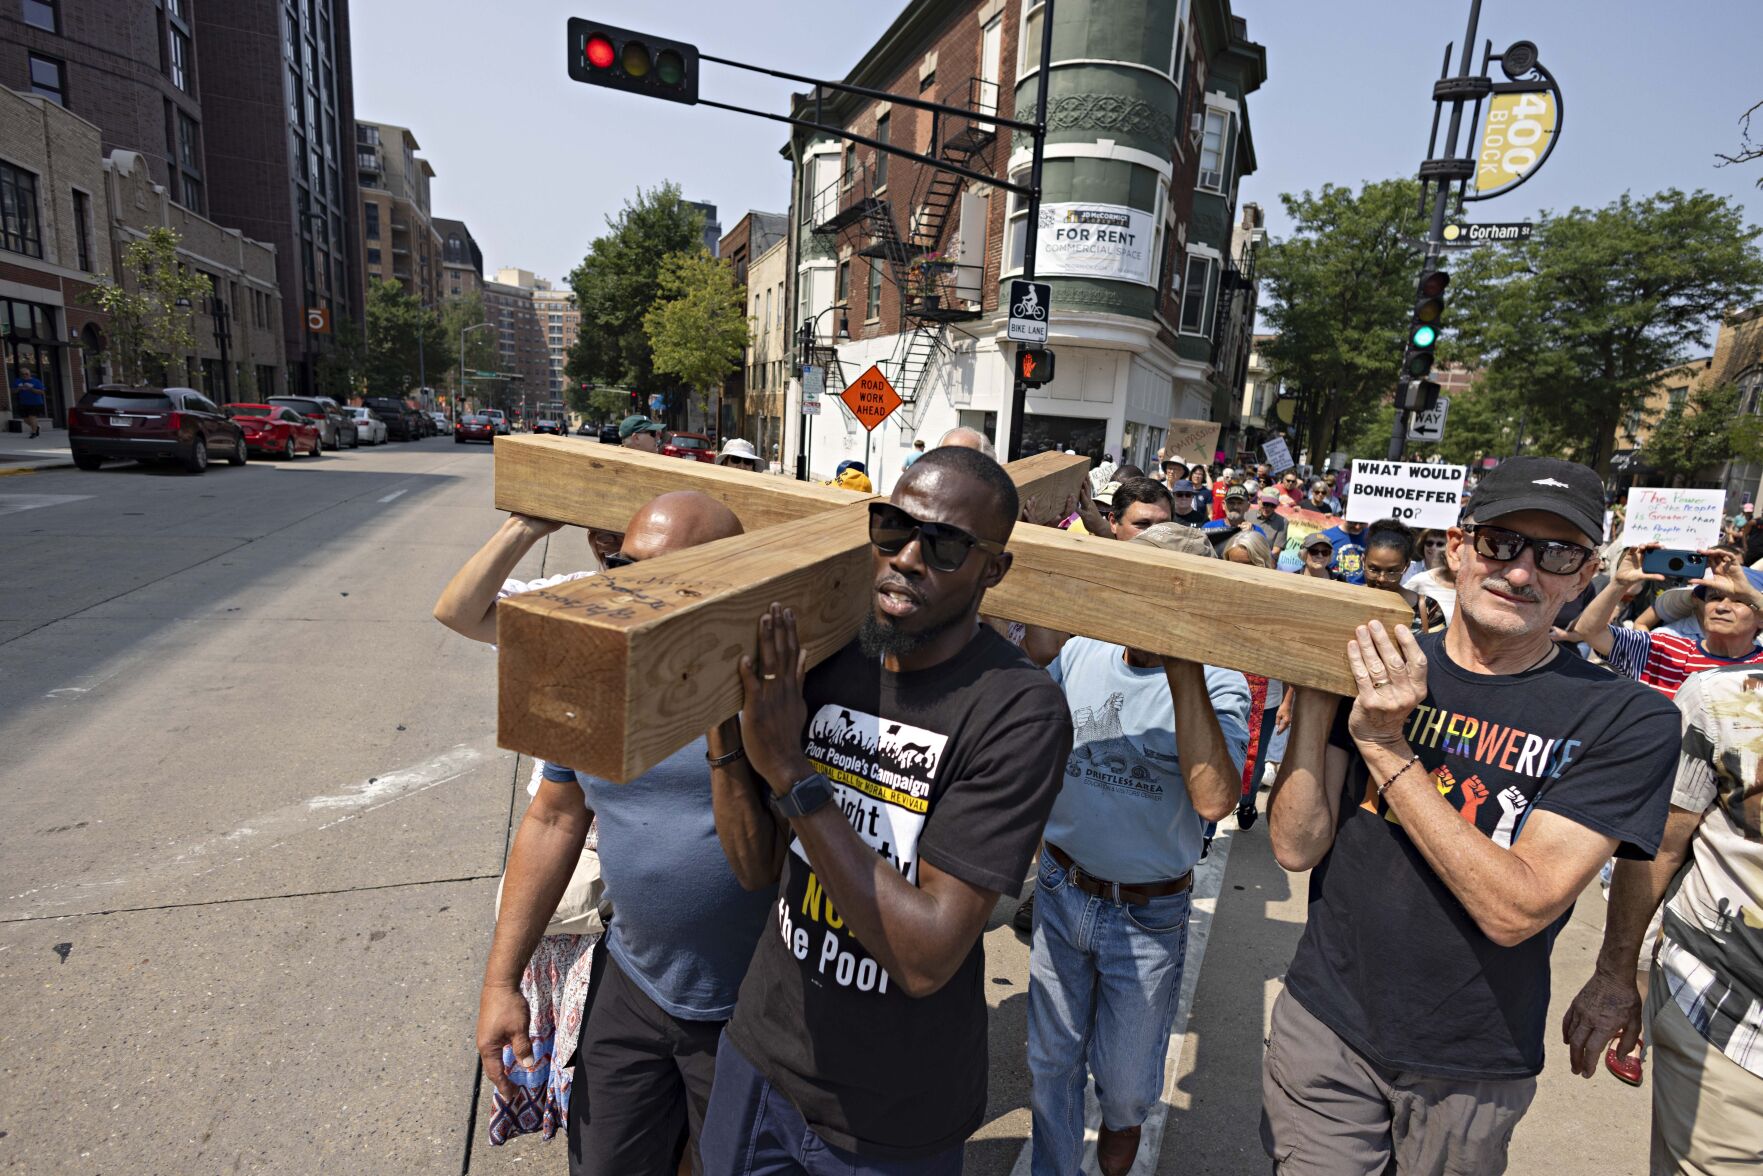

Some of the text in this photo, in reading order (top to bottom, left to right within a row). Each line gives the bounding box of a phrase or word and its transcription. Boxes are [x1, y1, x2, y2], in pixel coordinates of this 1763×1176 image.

[1480, 109, 1509, 175] BLOCK
[1502, 92, 1547, 175] 400
[1056, 228, 1136, 247] FOR RENT
[1469, 224, 1519, 239] Gorham
[1522, 227, 1530, 235] St
[1045, 243, 1142, 260] COMMERCIAL SPACE
[1011, 323, 1044, 336] BIKE LANE
[861, 379, 884, 391] ROAD
[859, 391, 884, 403] WORK
[856, 404, 886, 416] AHEAD
[1415, 412, 1442, 424] WAY
[1358, 462, 1462, 480] WHAT WOULD
[1353, 483, 1457, 504] BONHOEFFER
[1640, 490, 1666, 504] The
[1391, 506, 1422, 520] DO?
[1648, 511, 1688, 521] Greater
[1692, 515, 1715, 523] than
[805, 741, 930, 798] Poor People's Campaign
[1086, 767, 1163, 793] DRIFTLESS AREA
[837, 768, 855, 784] CALL
[865, 781, 887, 798] MORAL
[891, 791, 925, 811] REVIVAL
[832, 787, 880, 837] ight
